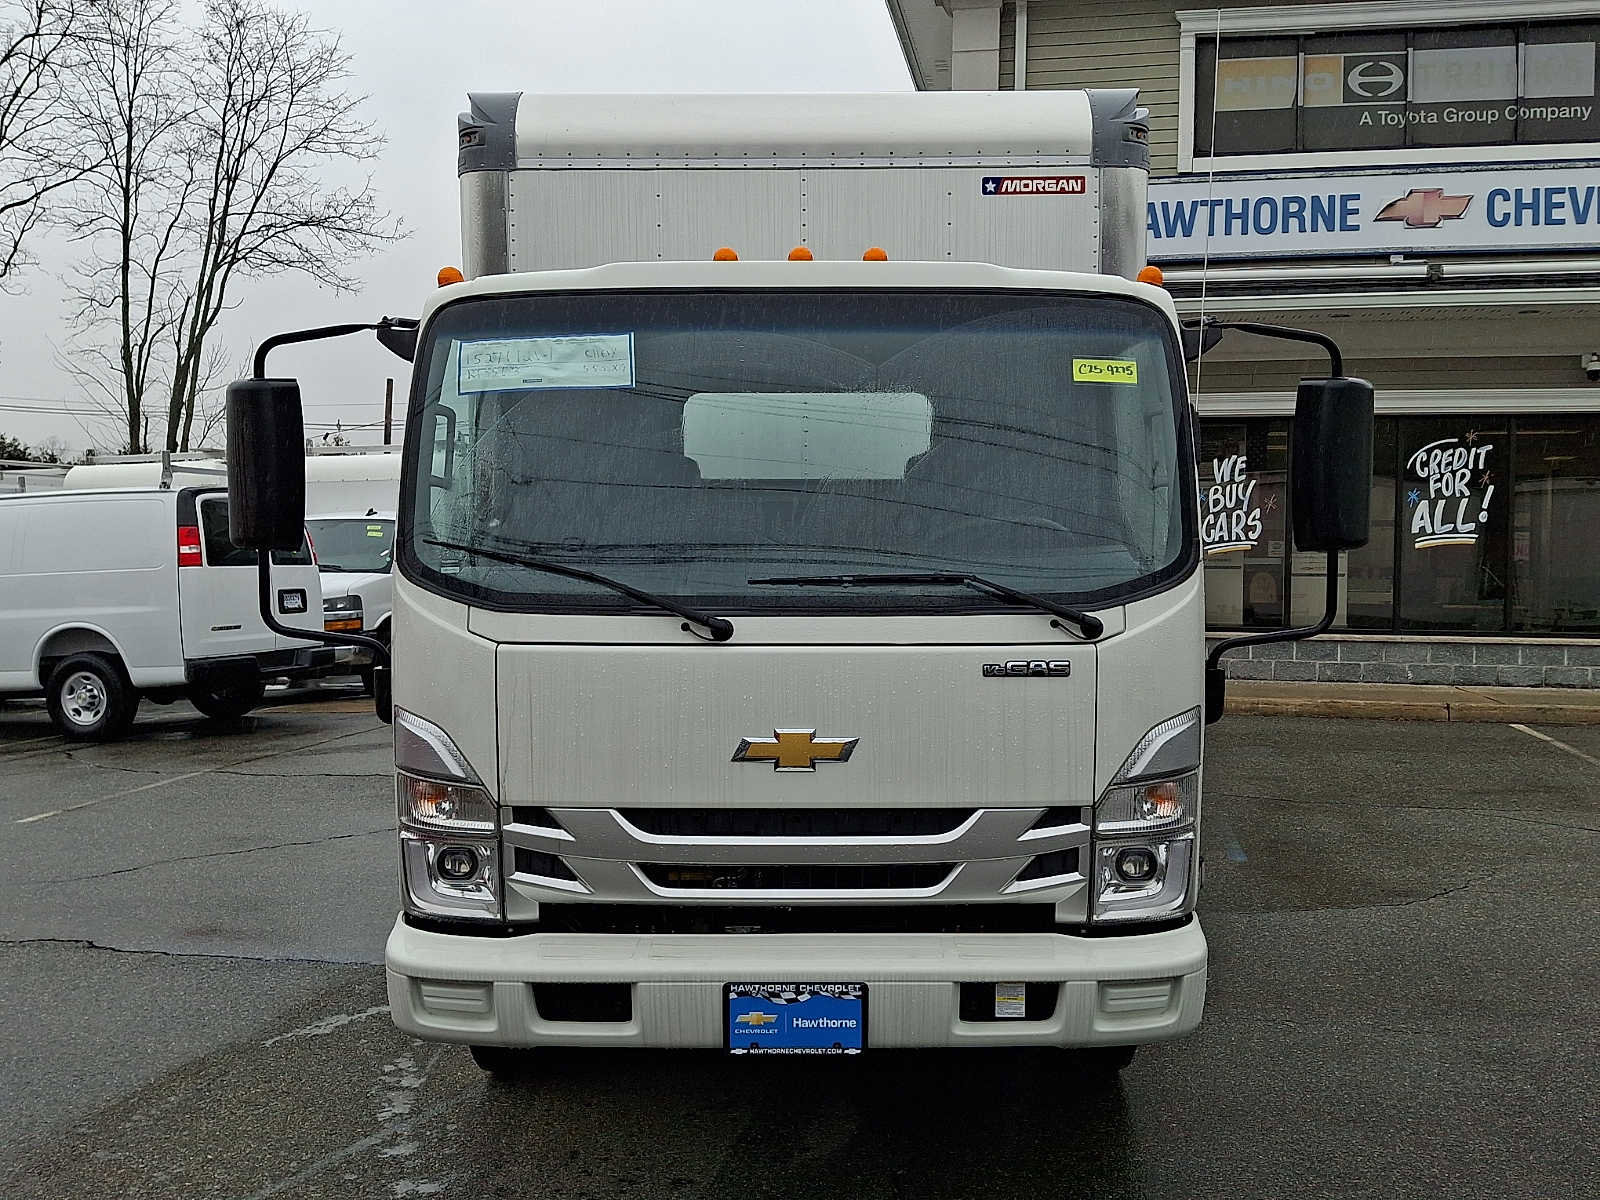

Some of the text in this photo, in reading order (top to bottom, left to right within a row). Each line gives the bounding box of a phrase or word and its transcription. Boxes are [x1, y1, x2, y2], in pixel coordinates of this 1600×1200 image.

[1359, 105, 1592, 129] A Toyota Group Company
[1001, 179, 1081, 193] MORGAN
[1487, 186, 1600, 227] CHEV
[1213, 455, 1247, 484] WE
[1415, 445, 1493, 478] CREDIT
[1208, 480, 1257, 513] BUY
[1429, 468, 1471, 499] FOR
[1202, 508, 1262, 542] CARS
[730, 984, 861, 992] HAWTHORNE CHEVROLET
[792, 1017, 857, 1028] Hawthorne
